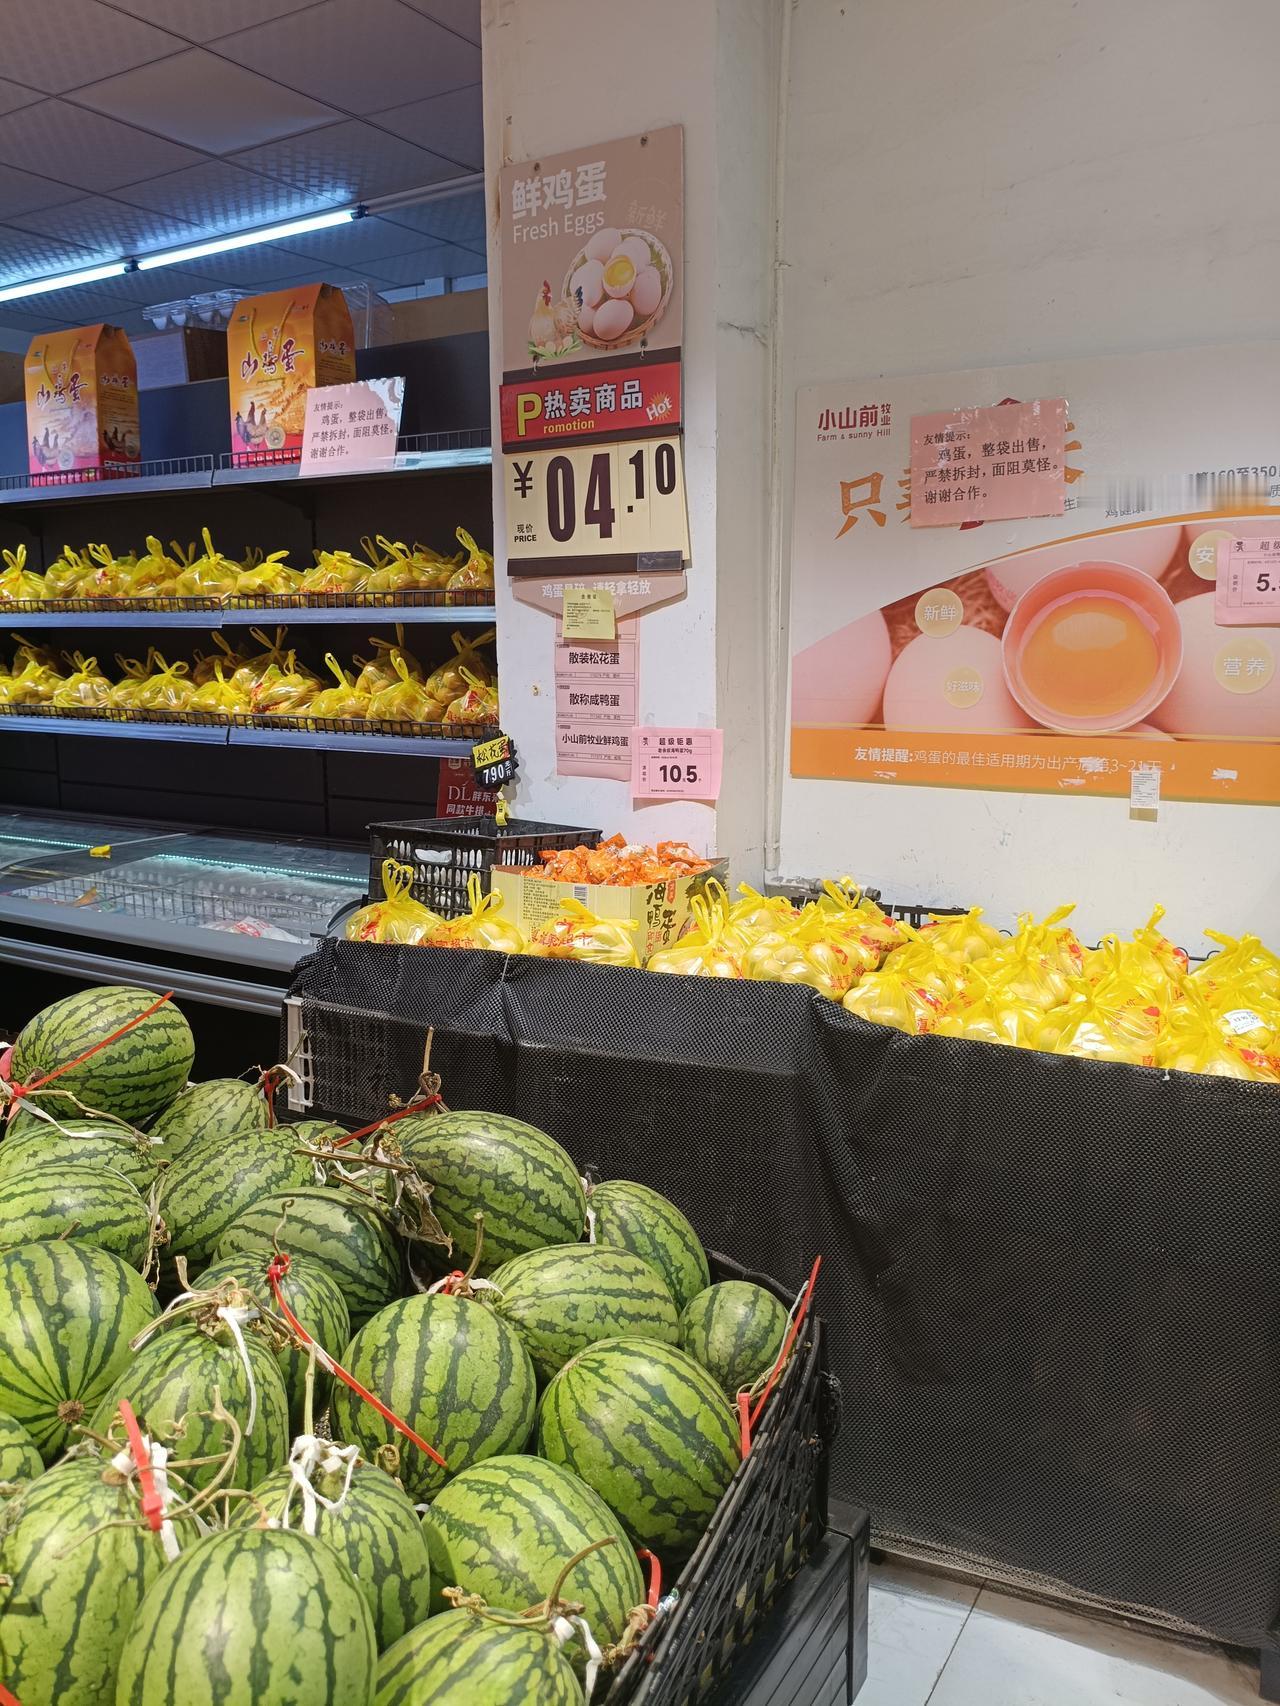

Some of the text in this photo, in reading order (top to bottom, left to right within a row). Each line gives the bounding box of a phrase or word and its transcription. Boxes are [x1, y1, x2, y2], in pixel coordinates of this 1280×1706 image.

[511, 161, 607, 219] 鲜鸡蛋
[513, 210, 605, 244] Fresh Eggs
[544, 379, 644, 420] 热卖商品
[646, 396, 673, 421] Hot
[818, 403, 891, 431] 小山前 牧业
[817, 433, 838, 442] Farm
[848, 431, 873, 441] sunny
[876, 428, 891, 437] Hill
[516, 523, 533, 534] 现价
[514, 534, 537, 543] PRICE
[924, 605, 957, 621] 新鲜
[569, 652, 620, 665] 散装松花蛋
[1223, 656, 1265, 677] 营养
[569, 693, 620, 707] 散称咸鸭蛋
[562, 733, 629, 747] 小山前牧业鲜鸡蛋
